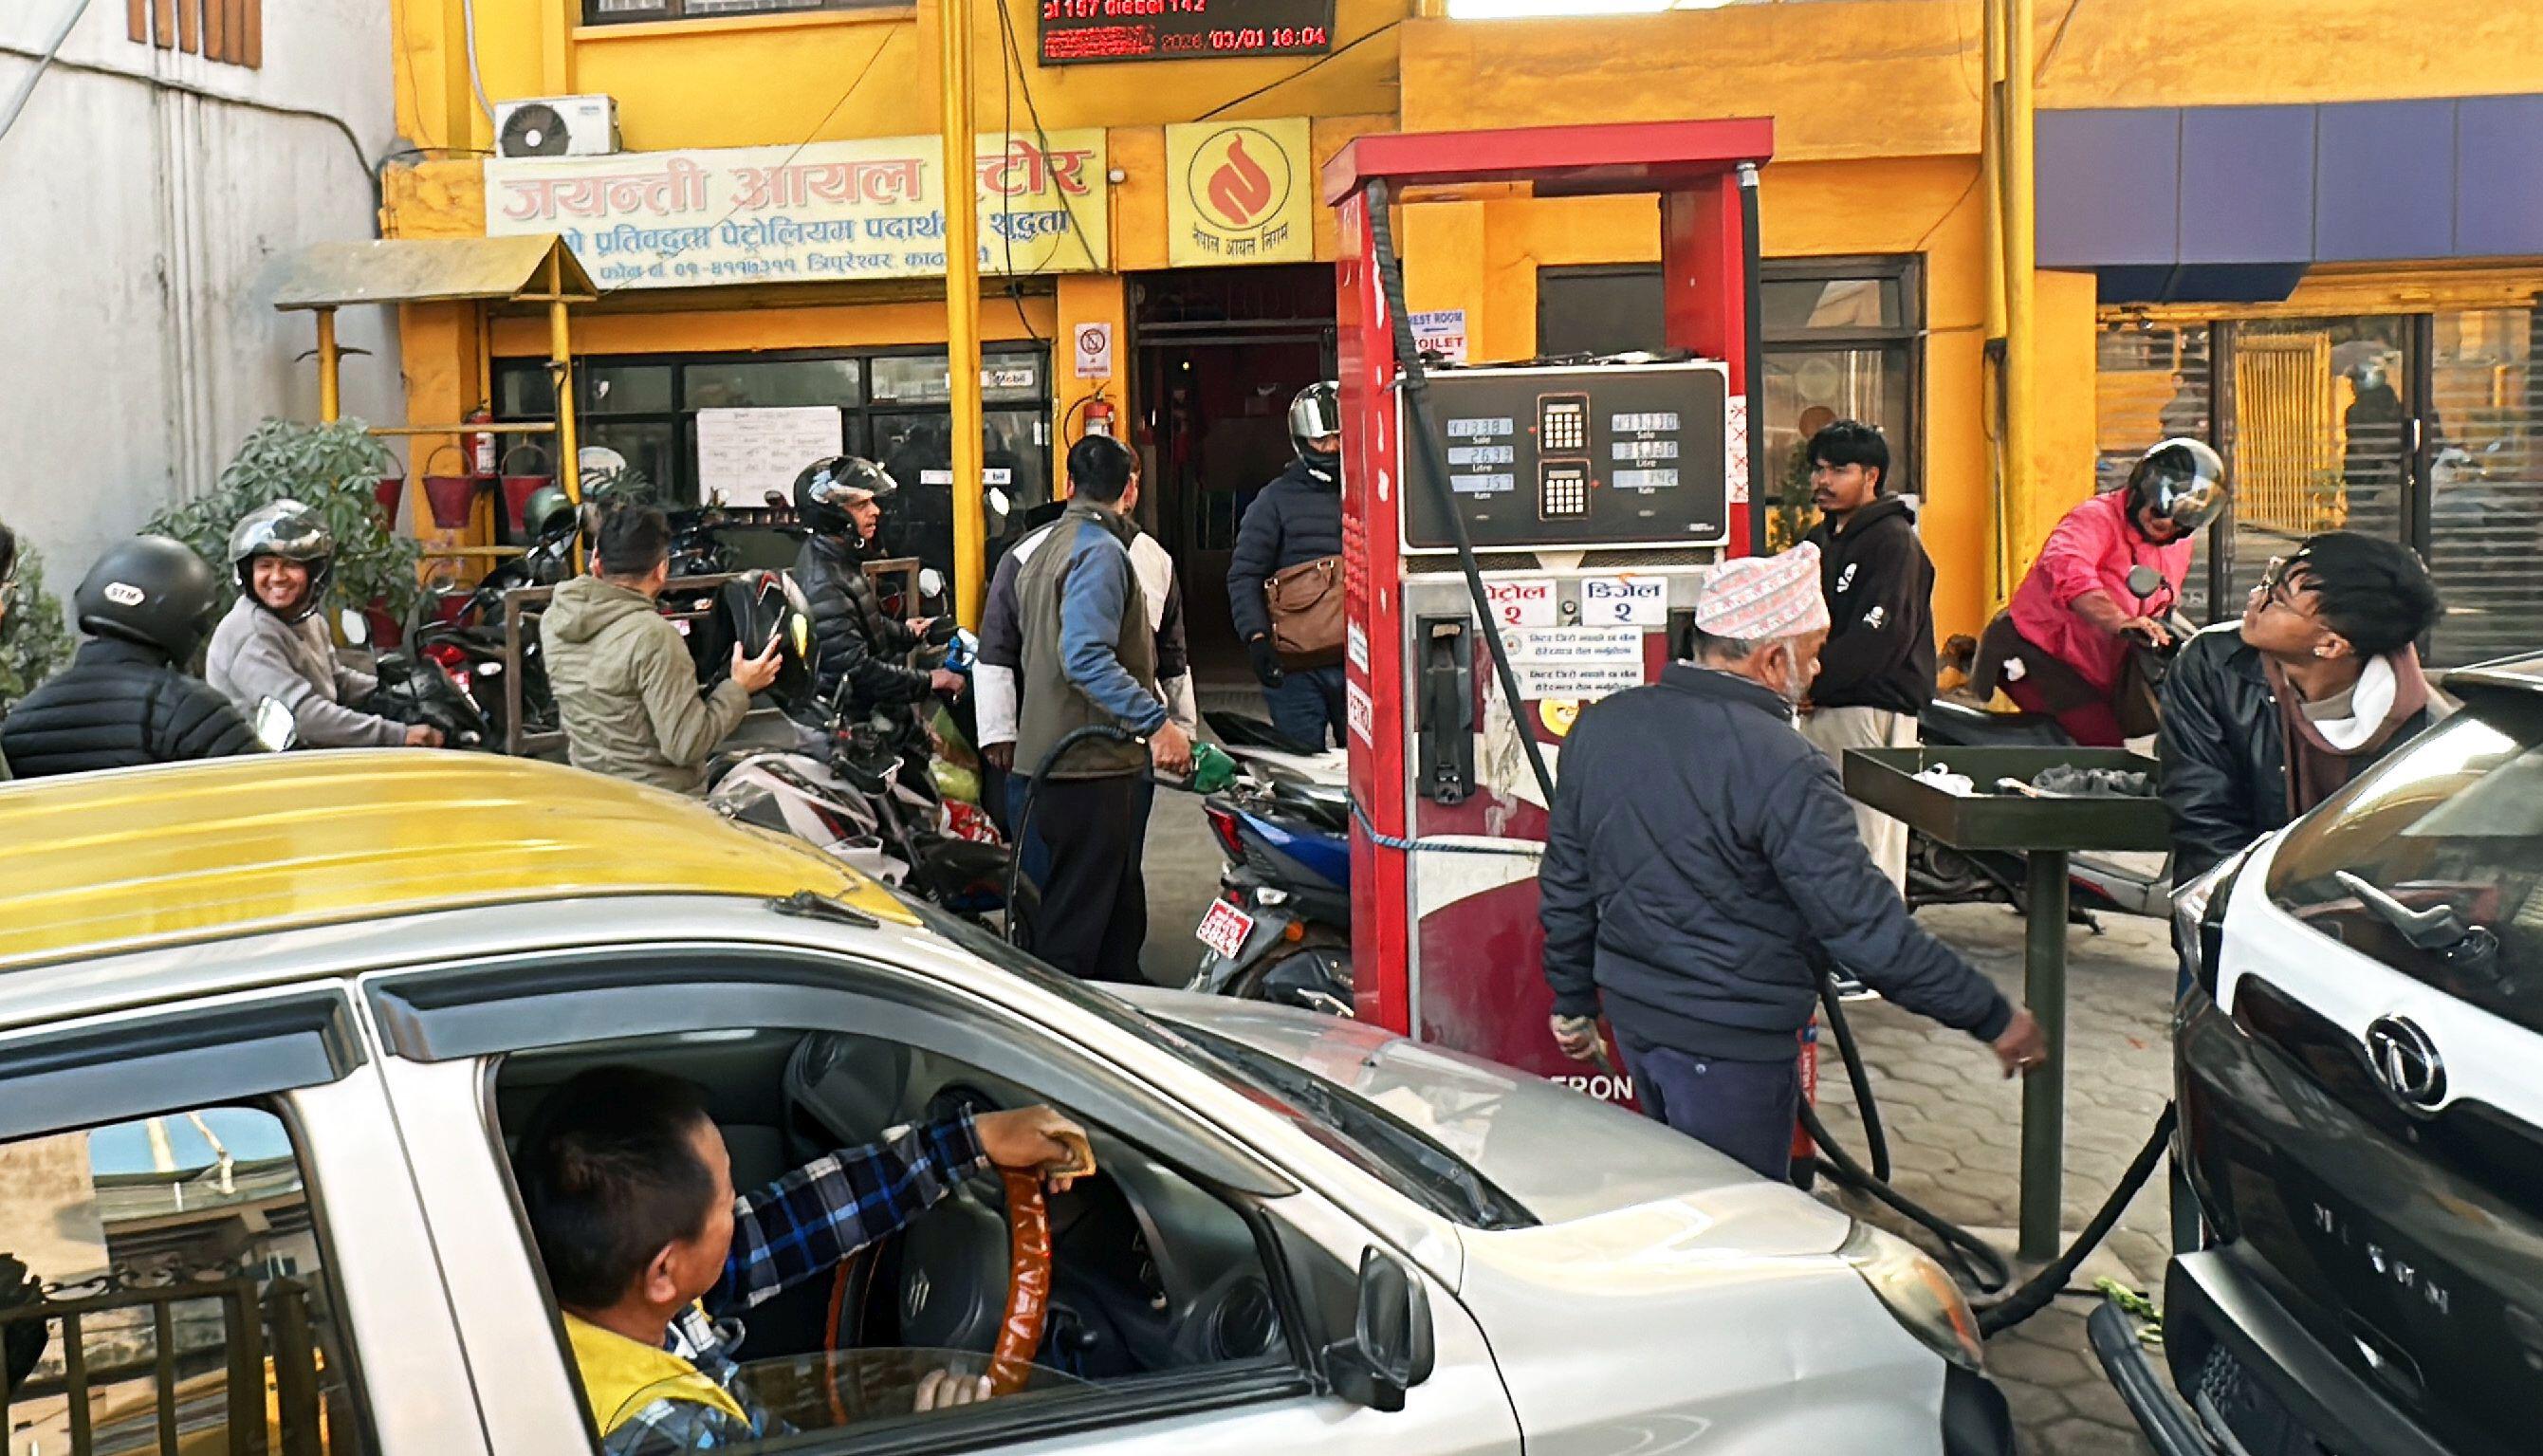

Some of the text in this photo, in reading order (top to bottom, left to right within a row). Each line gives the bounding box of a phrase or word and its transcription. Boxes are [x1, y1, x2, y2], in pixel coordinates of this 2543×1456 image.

[1272, 27, 1326, 46] 16:04
[501, 157, 710, 220] जयन्ती
[728, 159, 927, 210] आयल
[721, 215, 857, 252] पेट्रोलियम
[1225, 236, 1257, 256] आयल
[1434, 312, 1463, 323] ROOM
[1416, 337, 1464, 351] OILET
[1504, 606, 1522, 625] २
[1614, 602, 1632, 622] २
[1550, 1075, 1633, 1101] RON
